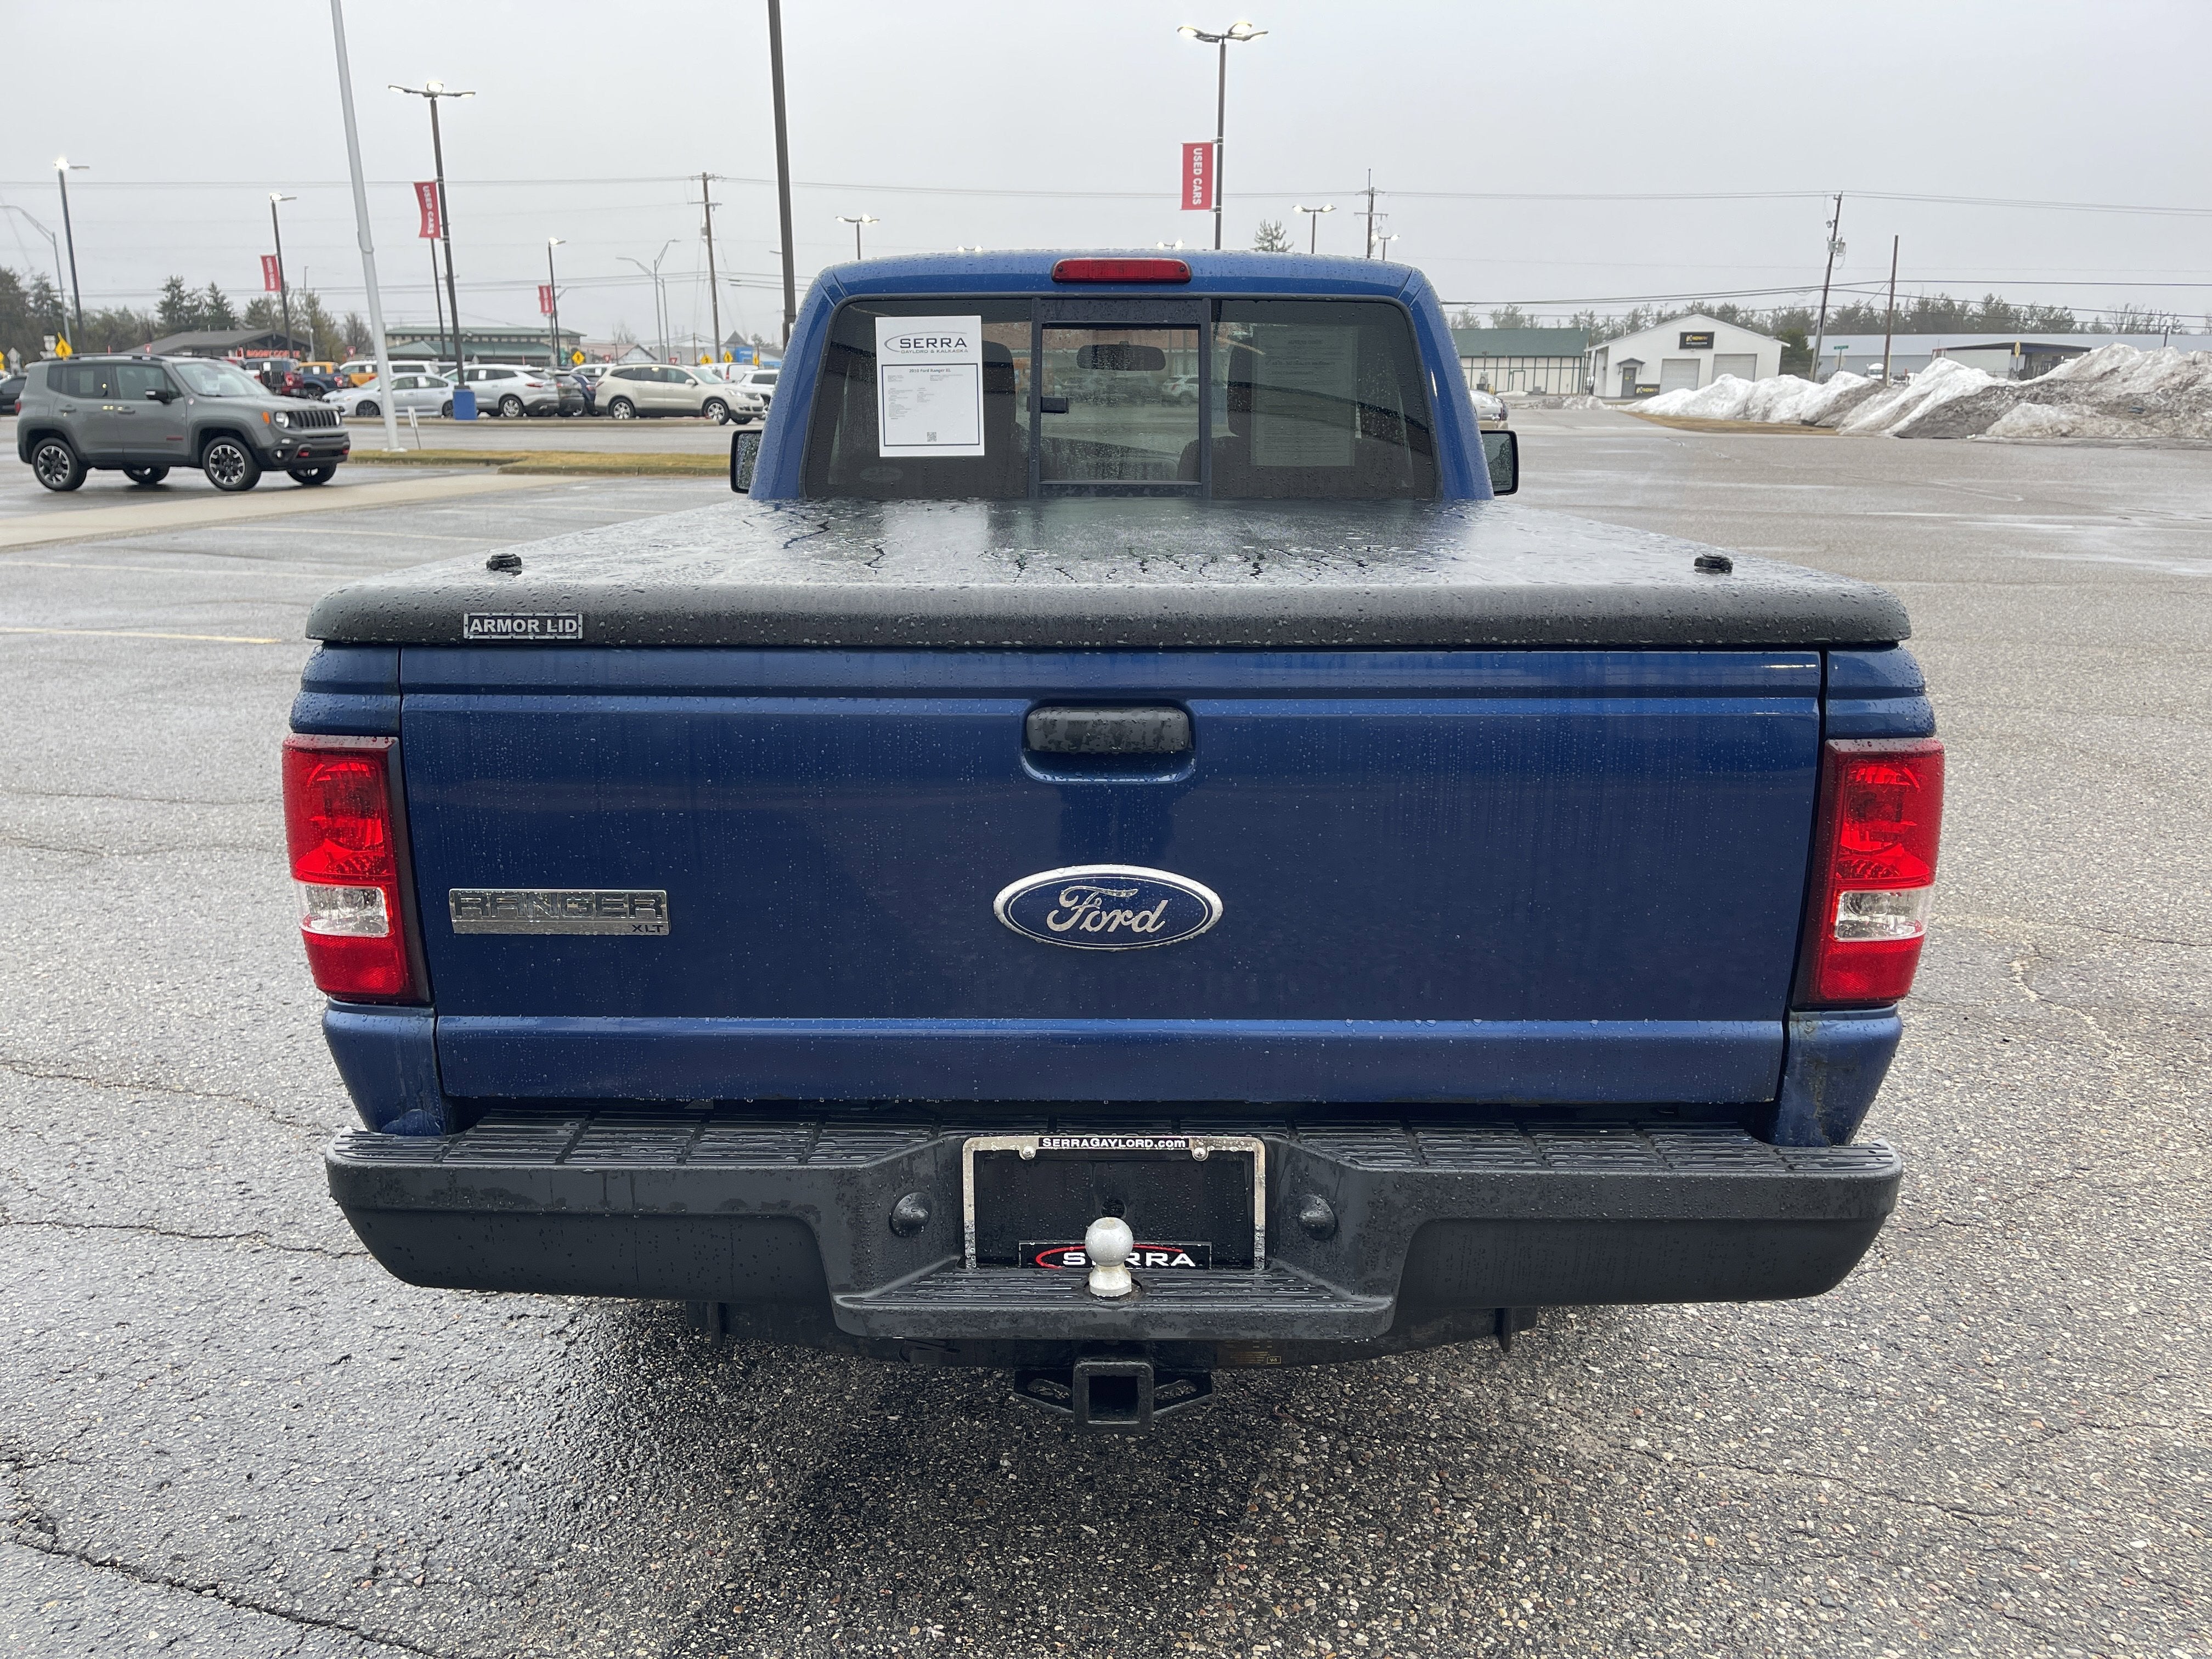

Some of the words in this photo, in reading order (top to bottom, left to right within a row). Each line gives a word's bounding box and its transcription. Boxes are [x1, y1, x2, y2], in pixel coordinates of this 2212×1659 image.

[1193, 148, 1203, 175] USED
[1192, 178, 1203, 205] CARS
[900, 337, 968, 348] SERRA
[470, 618, 540, 633] ARMOR
[546, 619, 577, 633] LID
[454, 891, 664, 918] RANGER
[1046, 885, 1169, 933] Ford
[631, 924, 664, 933] XLT
[1042, 1137, 1186, 1148] SERRAGAYLORD.com
[1063, 1252, 1196, 1267] SRRA
